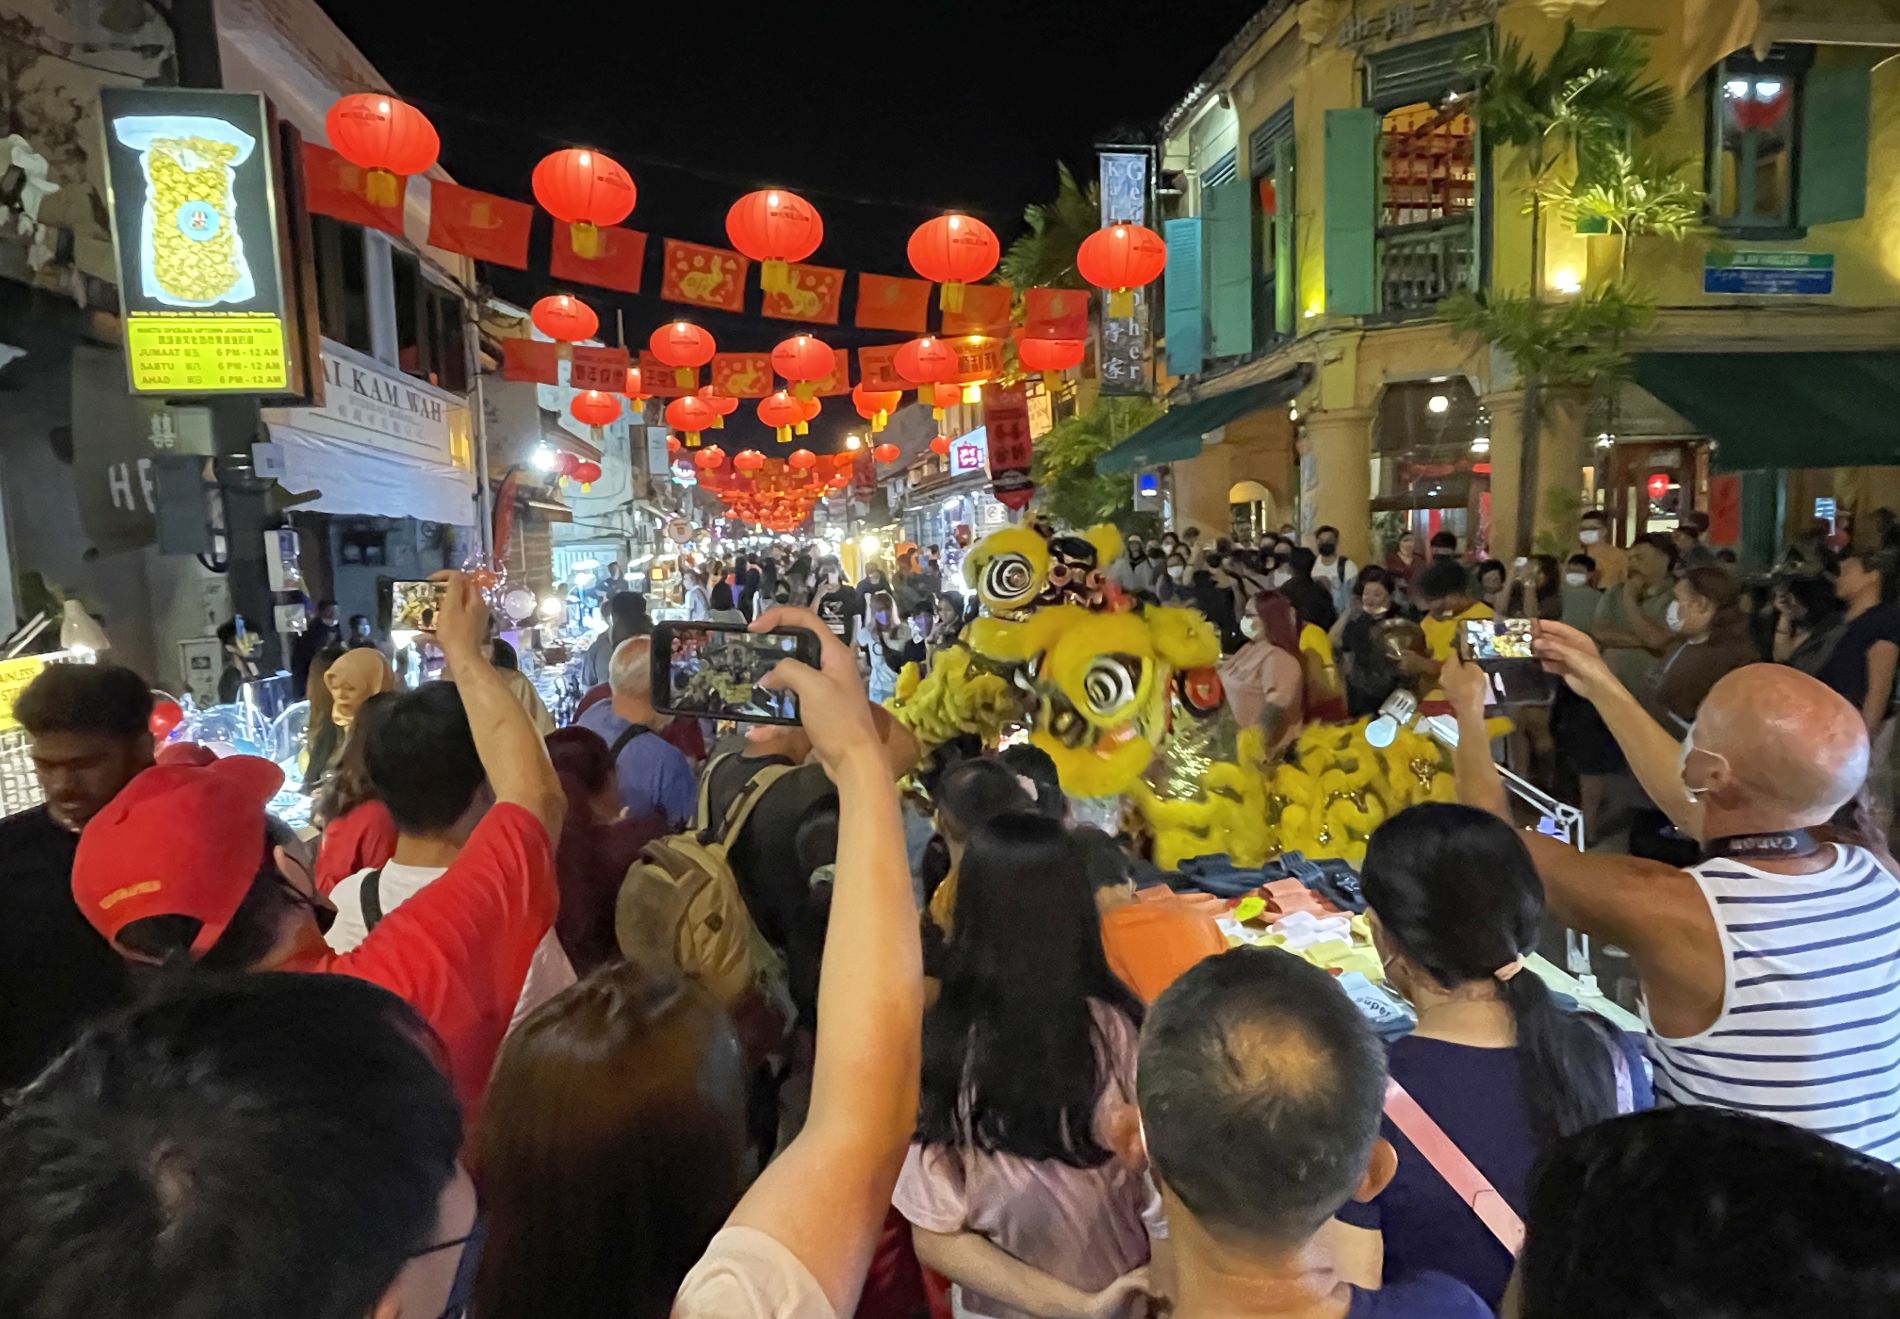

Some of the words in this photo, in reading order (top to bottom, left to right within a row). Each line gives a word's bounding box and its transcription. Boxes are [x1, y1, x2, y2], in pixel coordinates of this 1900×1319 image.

[139, 348, 180, 357] JUMAAT
[140, 362, 175, 370] SABTU
[218, 362, 224, 370] 6
[227, 362, 241, 370] PM
[251, 362, 262, 370] 12
[265, 362, 280, 370] AM
[142, 376, 171, 384] AHAD
[219, 376, 225, 384] 6
[228, 376, 243, 384] PM
[252, 375, 263, 383] 12
[266, 375, 281, 383] AM
[352, 368, 399, 408] KAM
[406, 390, 442, 423] WAH
